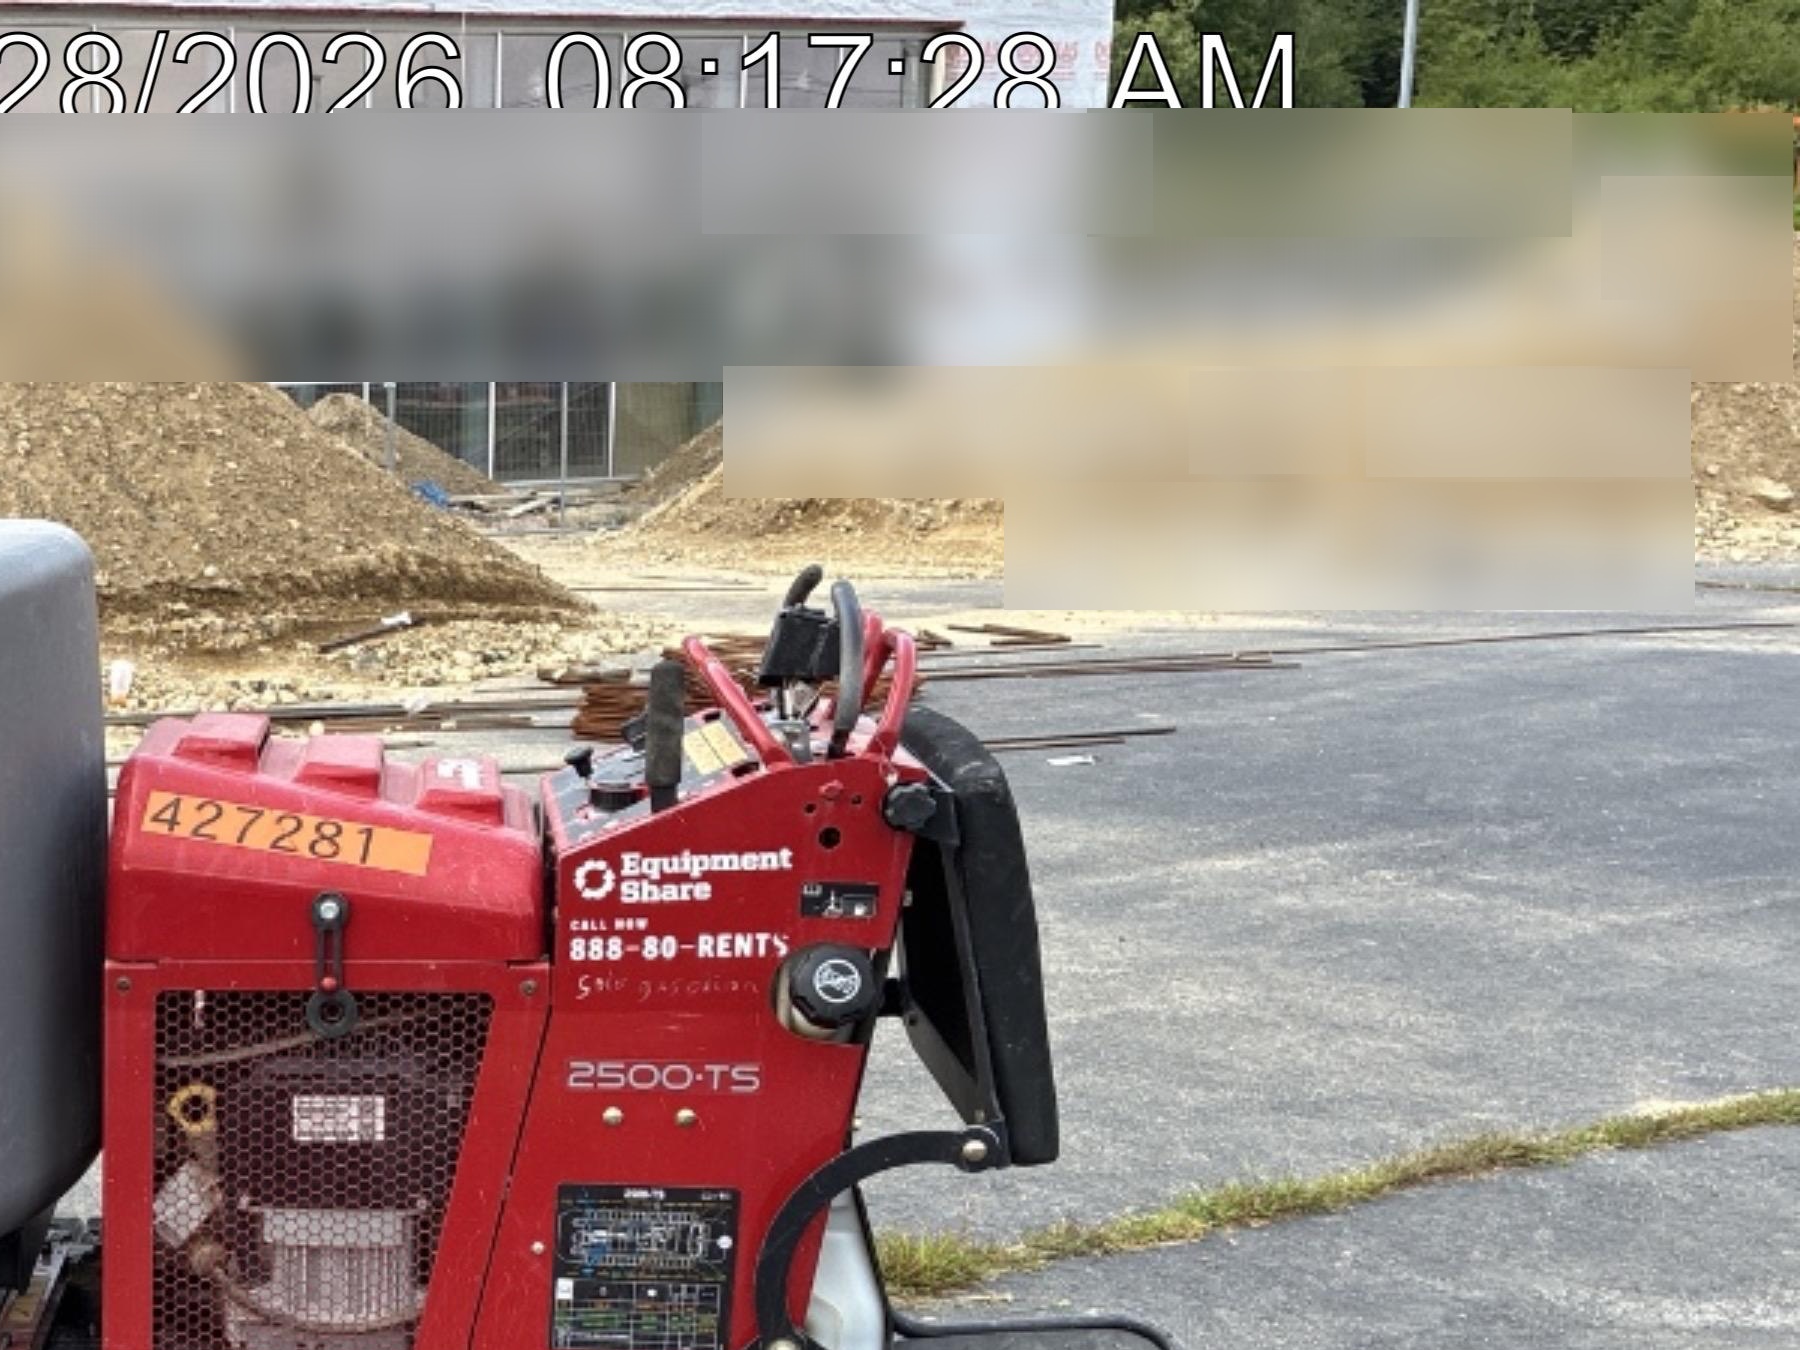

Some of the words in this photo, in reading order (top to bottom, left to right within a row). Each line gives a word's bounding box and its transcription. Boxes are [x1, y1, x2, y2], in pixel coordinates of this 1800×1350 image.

[150, 796, 375, 864] 427281
[620, 848, 793, 879] Equipment
[620, 880, 712, 903] Share
[569, 918, 608, 931] CALL
